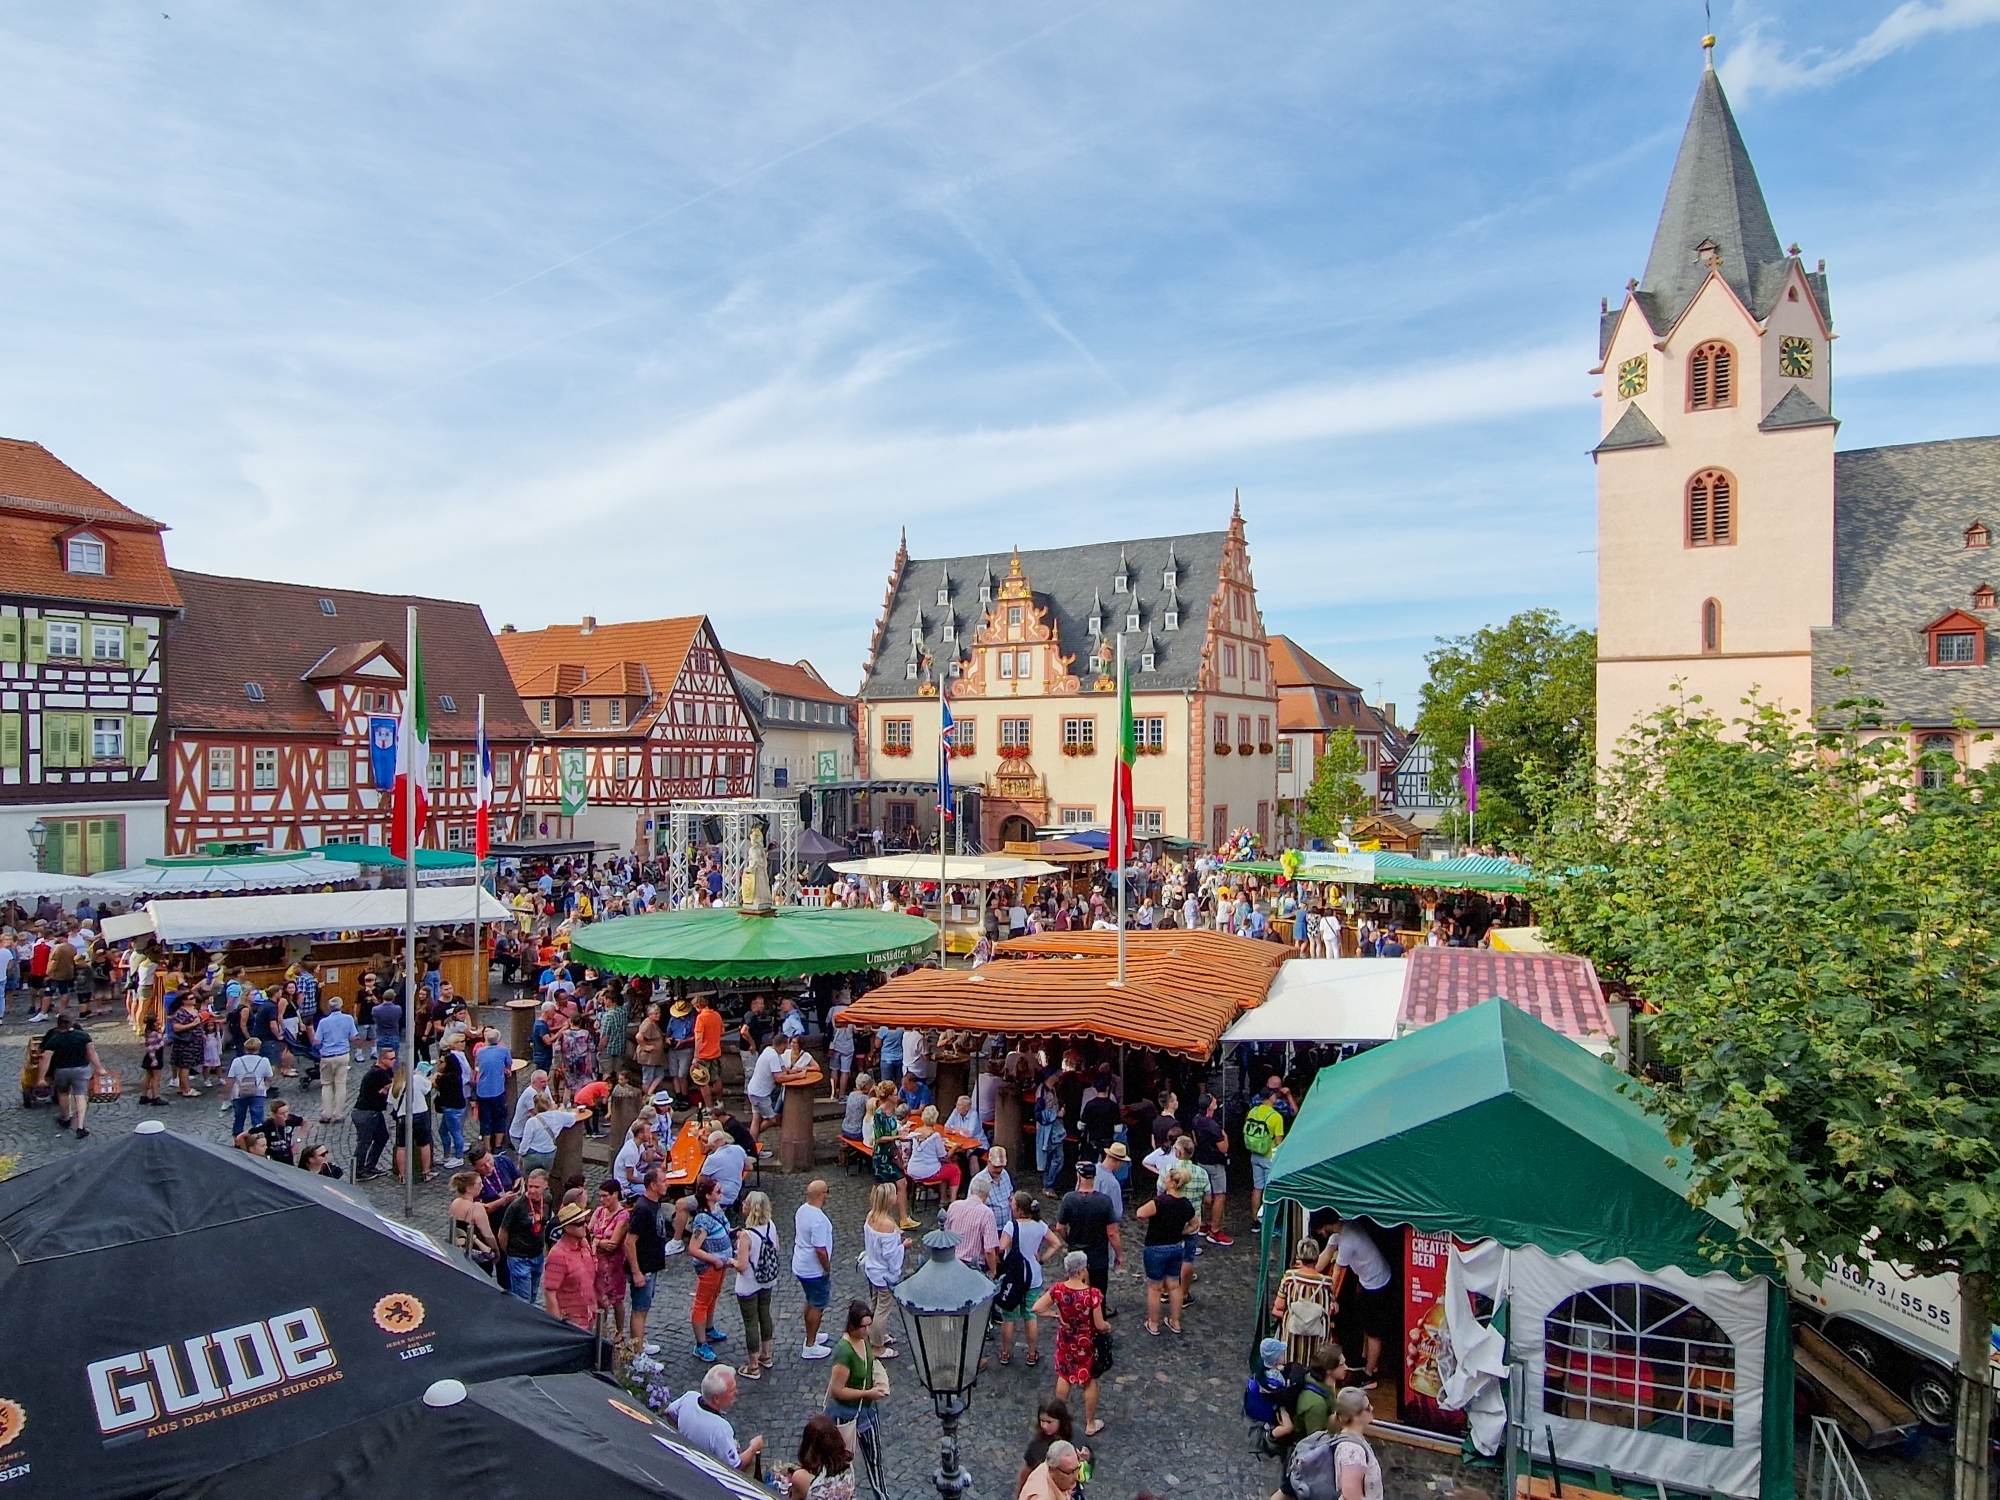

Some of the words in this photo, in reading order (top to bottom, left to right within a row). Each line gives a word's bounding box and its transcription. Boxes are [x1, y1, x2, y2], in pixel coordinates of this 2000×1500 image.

[866, 949, 907, 964] Umstädter
[1411, 1238, 1451, 1257] CREATES
[1412, 1252, 1435, 1268] BEER
[1866, 1277, 1886, 1296] 73
[399, 1344, 434, 1360] LIEBE
[147, 1421, 179, 1438] AUS
[182, 1411, 218, 1429] DEM
[220, 1391, 279, 1417] HERZEN
[281, 1370, 345, 1398] EUROPAS
